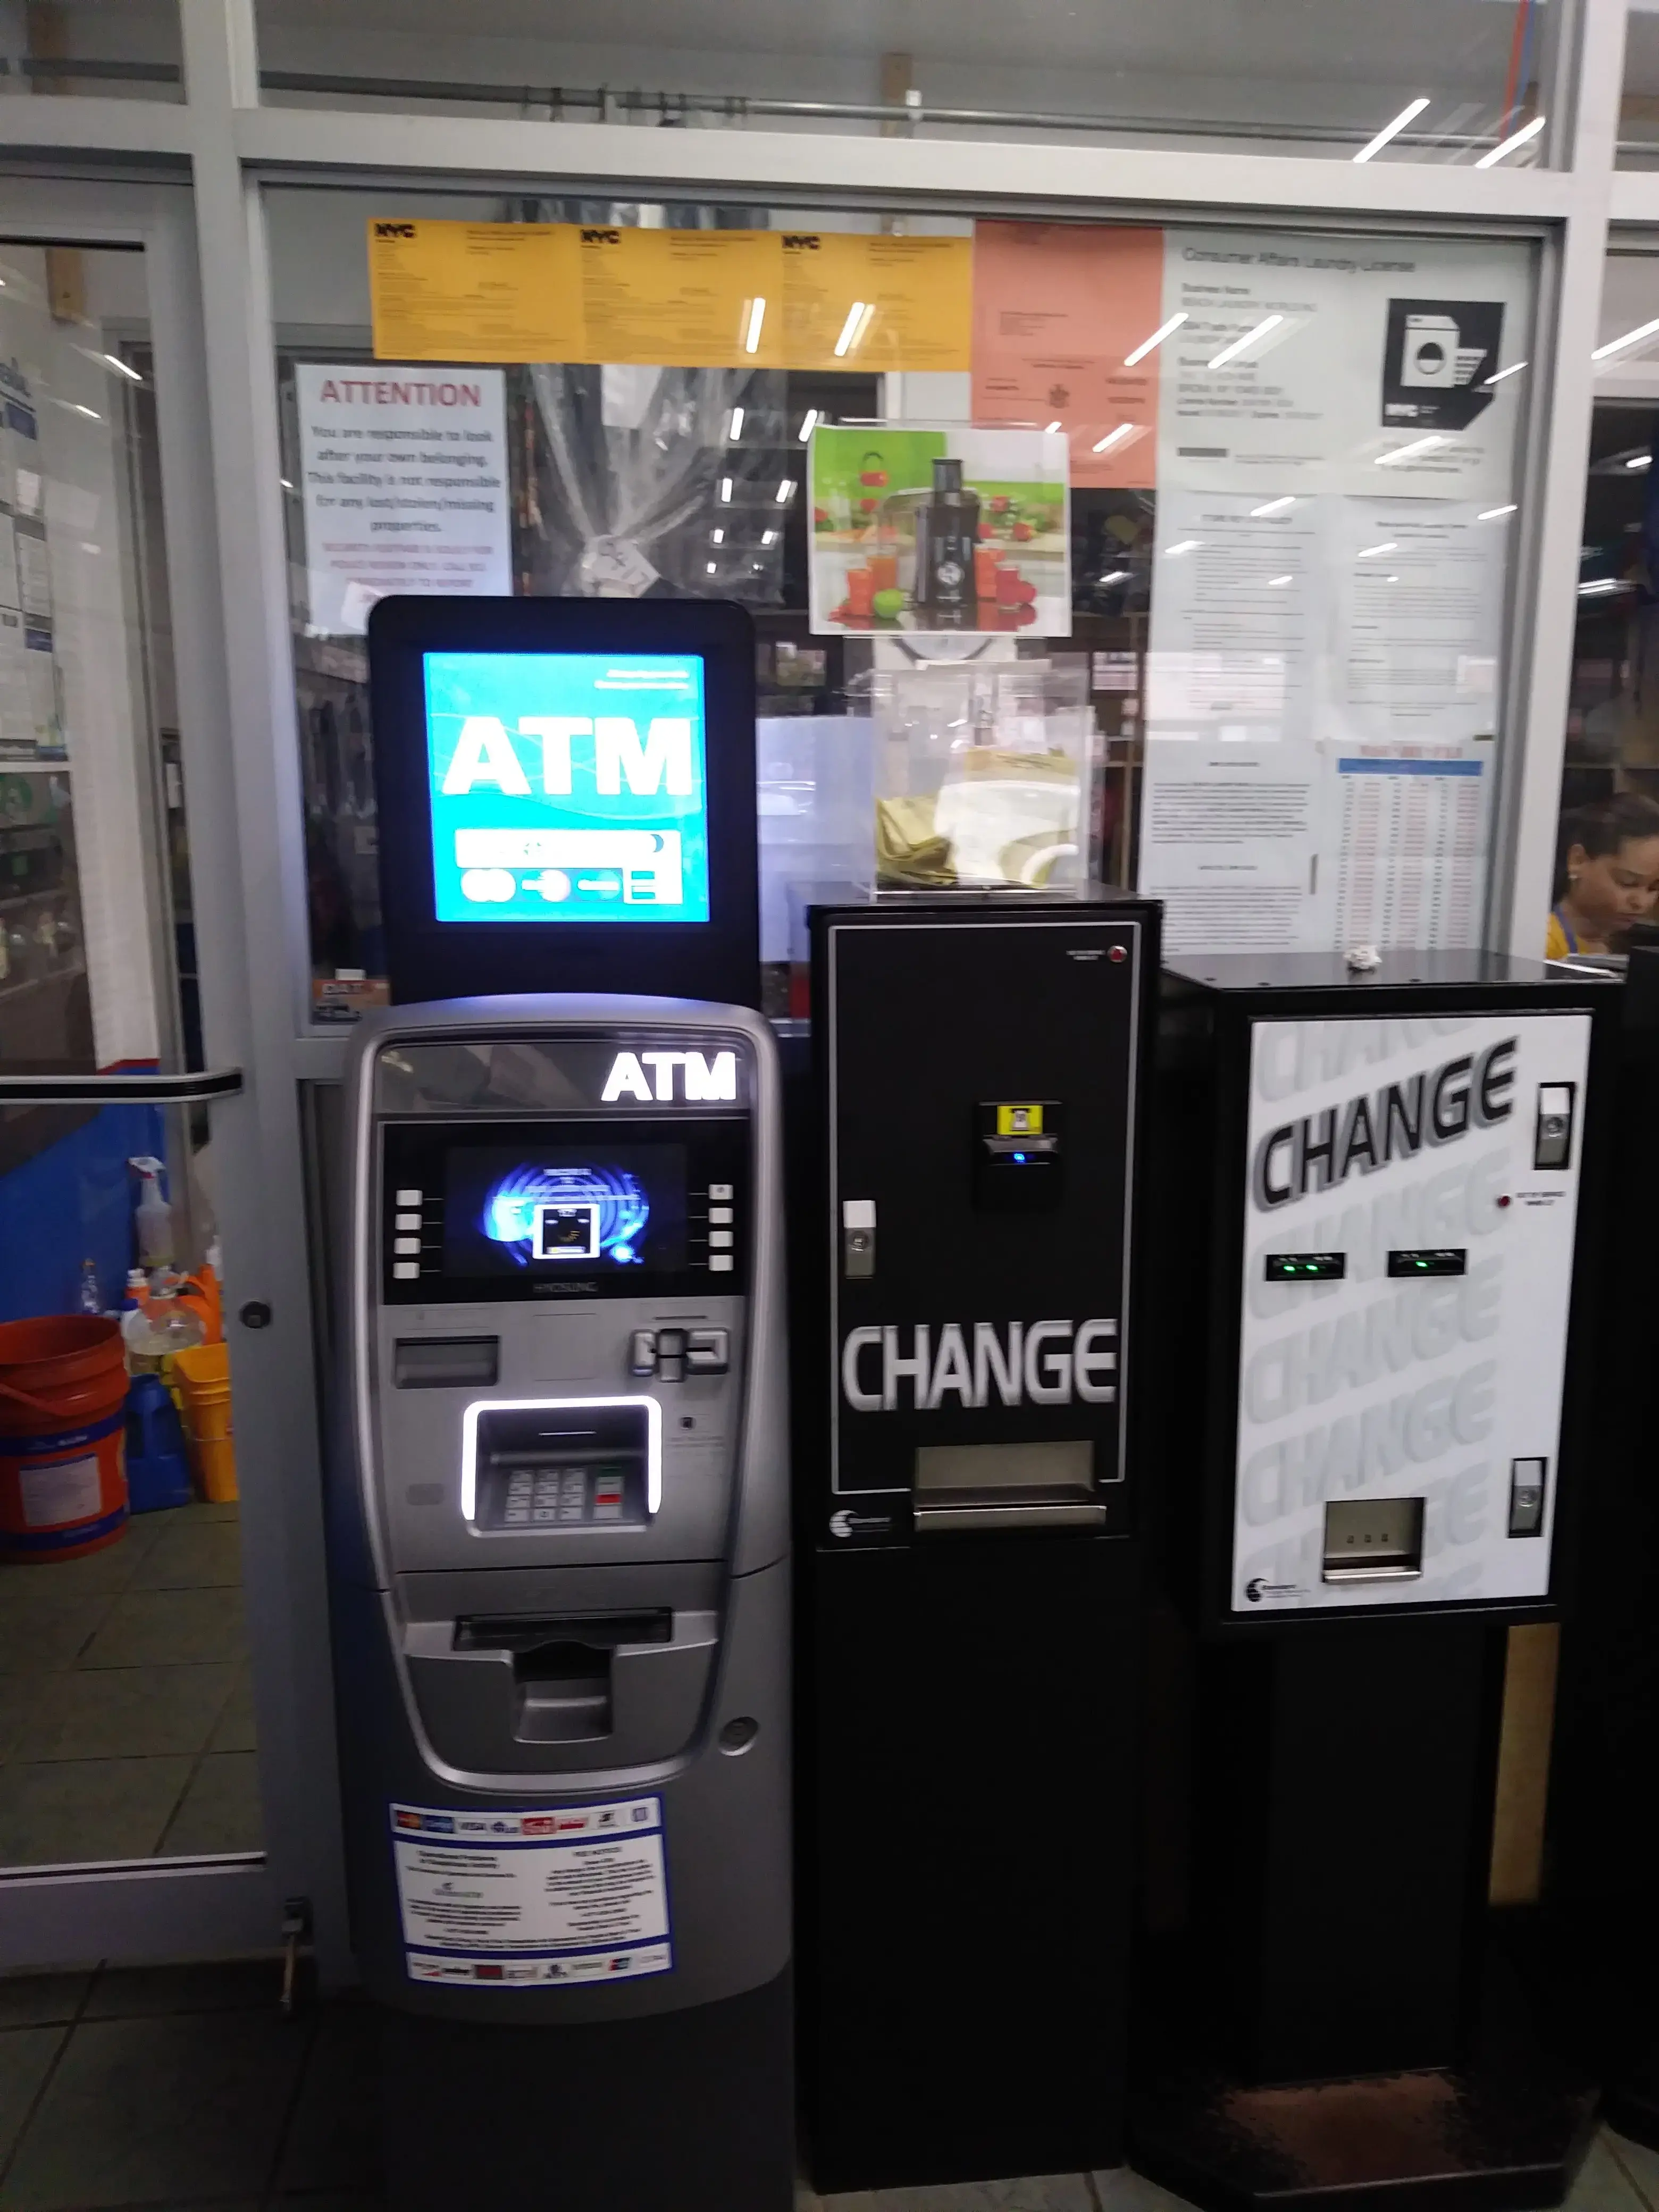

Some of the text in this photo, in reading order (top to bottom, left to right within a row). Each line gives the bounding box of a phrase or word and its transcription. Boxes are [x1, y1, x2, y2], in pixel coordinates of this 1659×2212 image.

[374, 223, 416, 238] NYC
[580, 230, 621, 243] NYC
[781, 236, 820, 249] NYC
[321, 380, 482, 406] ATTENTION
[311, 425, 492, 442] You are responsible to look
[317, 448, 349, 462] after
[354, 453, 382, 465] your
[387, 454, 416, 463] own
[308, 471, 501, 489] This facility is not responsible
[316, 494, 336, 507] for
[341, 498, 364, 510] any
[442, 716, 692, 795] ATM
[600, 1051, 737, 1101] ATM
[1253, 1035, 1521, 1212] CHANGE
[842, 1318, 1118, 1412] CHANGE
